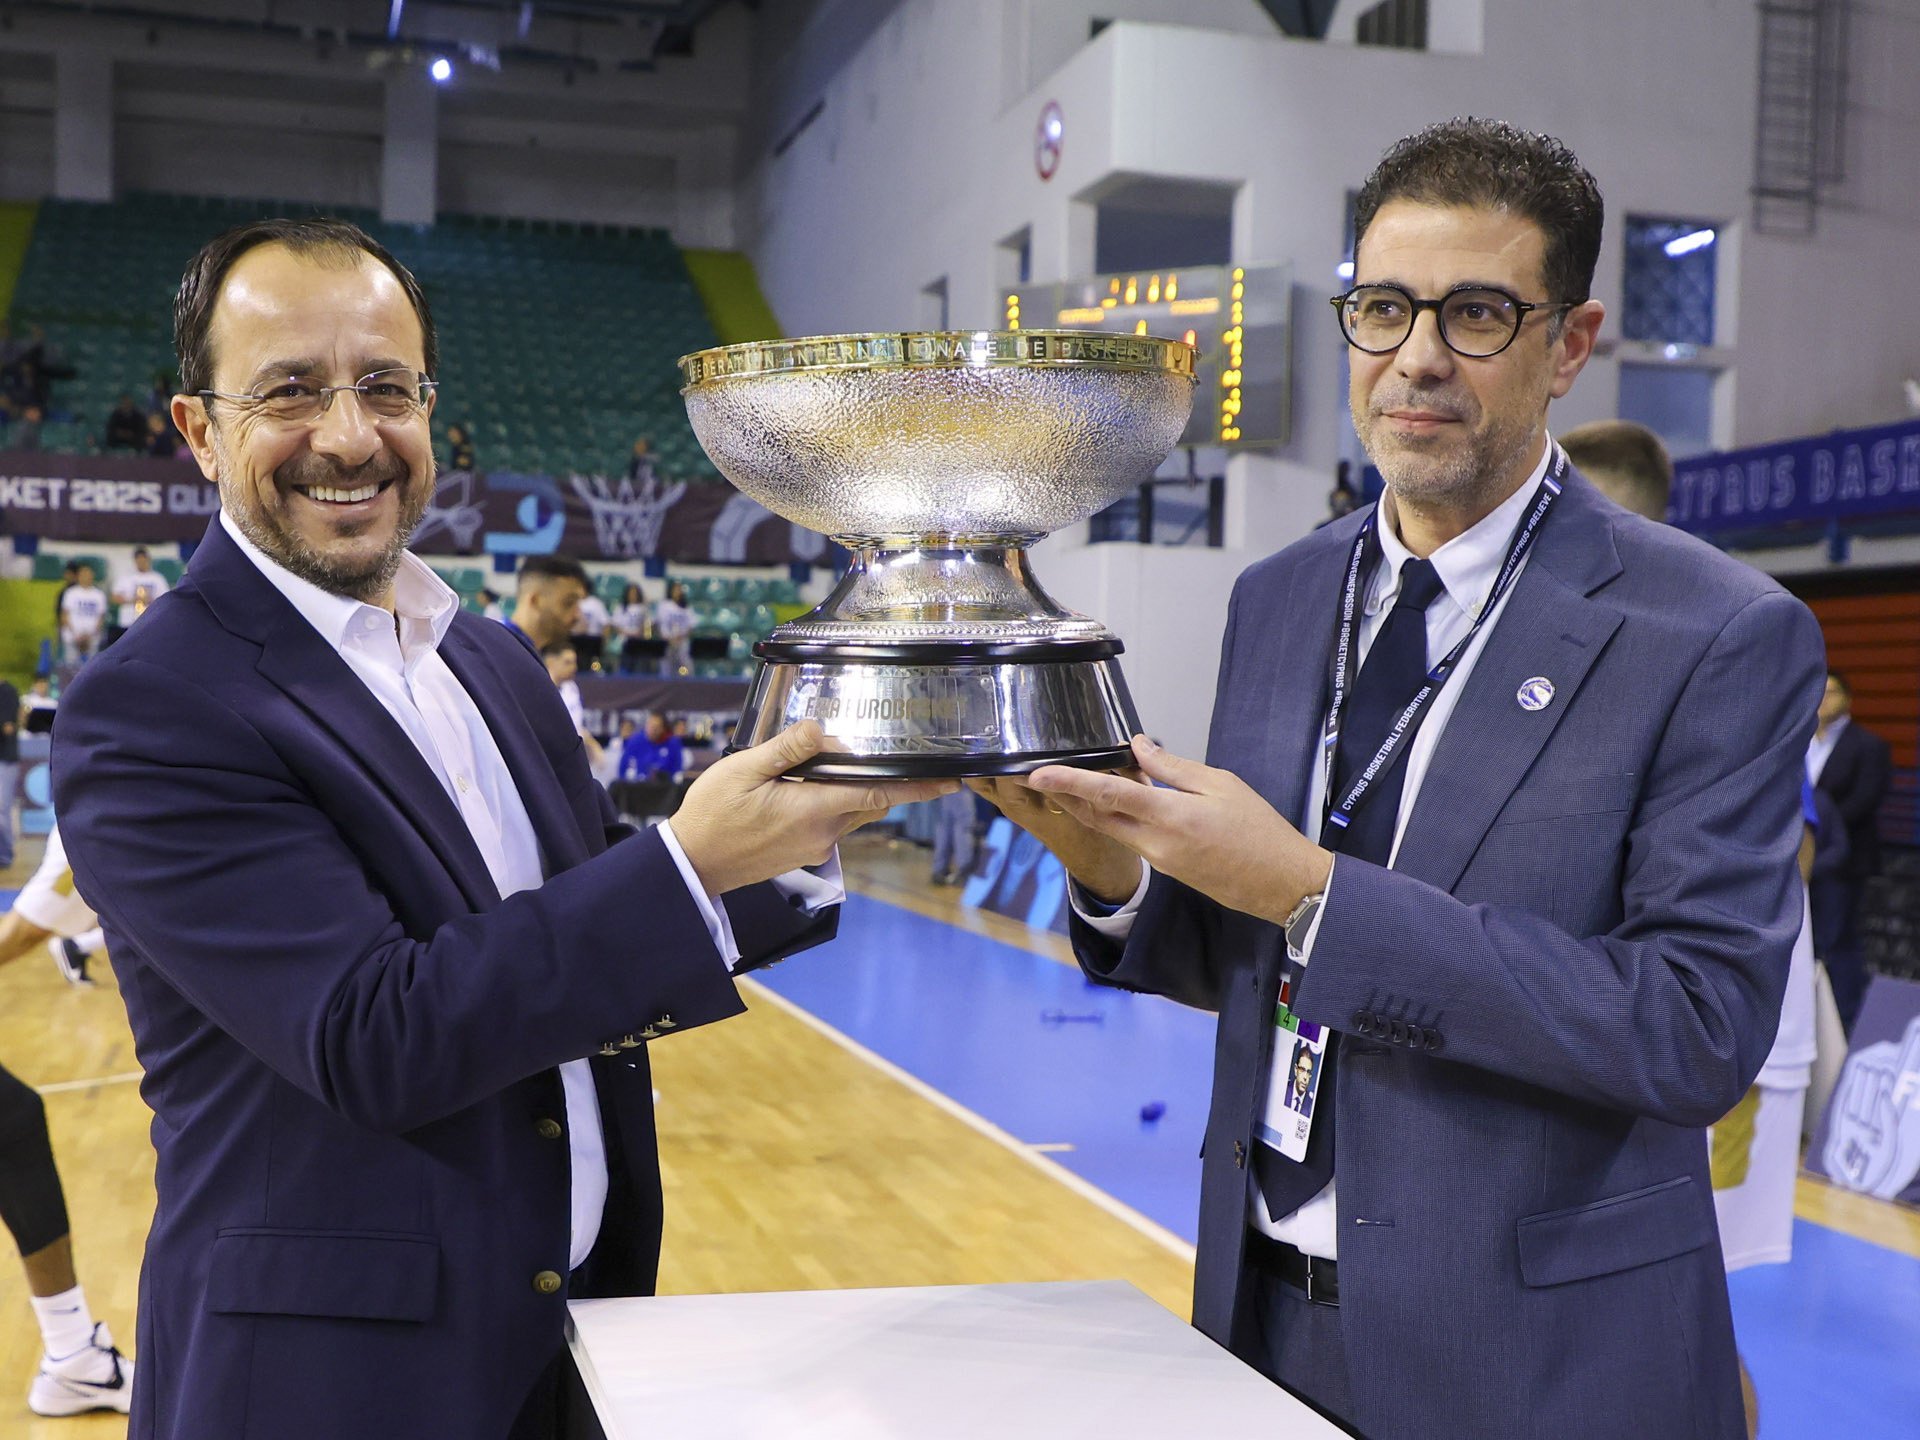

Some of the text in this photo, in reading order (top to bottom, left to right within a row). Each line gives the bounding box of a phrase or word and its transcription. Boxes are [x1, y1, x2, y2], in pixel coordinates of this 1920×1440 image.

[1017, 341, 1045, 357] DE
[69, 478, 162, 513] 2025
[1668, 454, 1796, 522] YPRUS
[1528, 492, 1552, 532] #BELIEVE
[1335, 622, 1351, 688] #BASKETCYPRUS
[1329, 690, 1343, 728] #BELIEVE
[1342, 686, 1432, 811] CYPRUS BASKETBALL FEDERATION
[1283, 1013, 1291, 1027] 4
